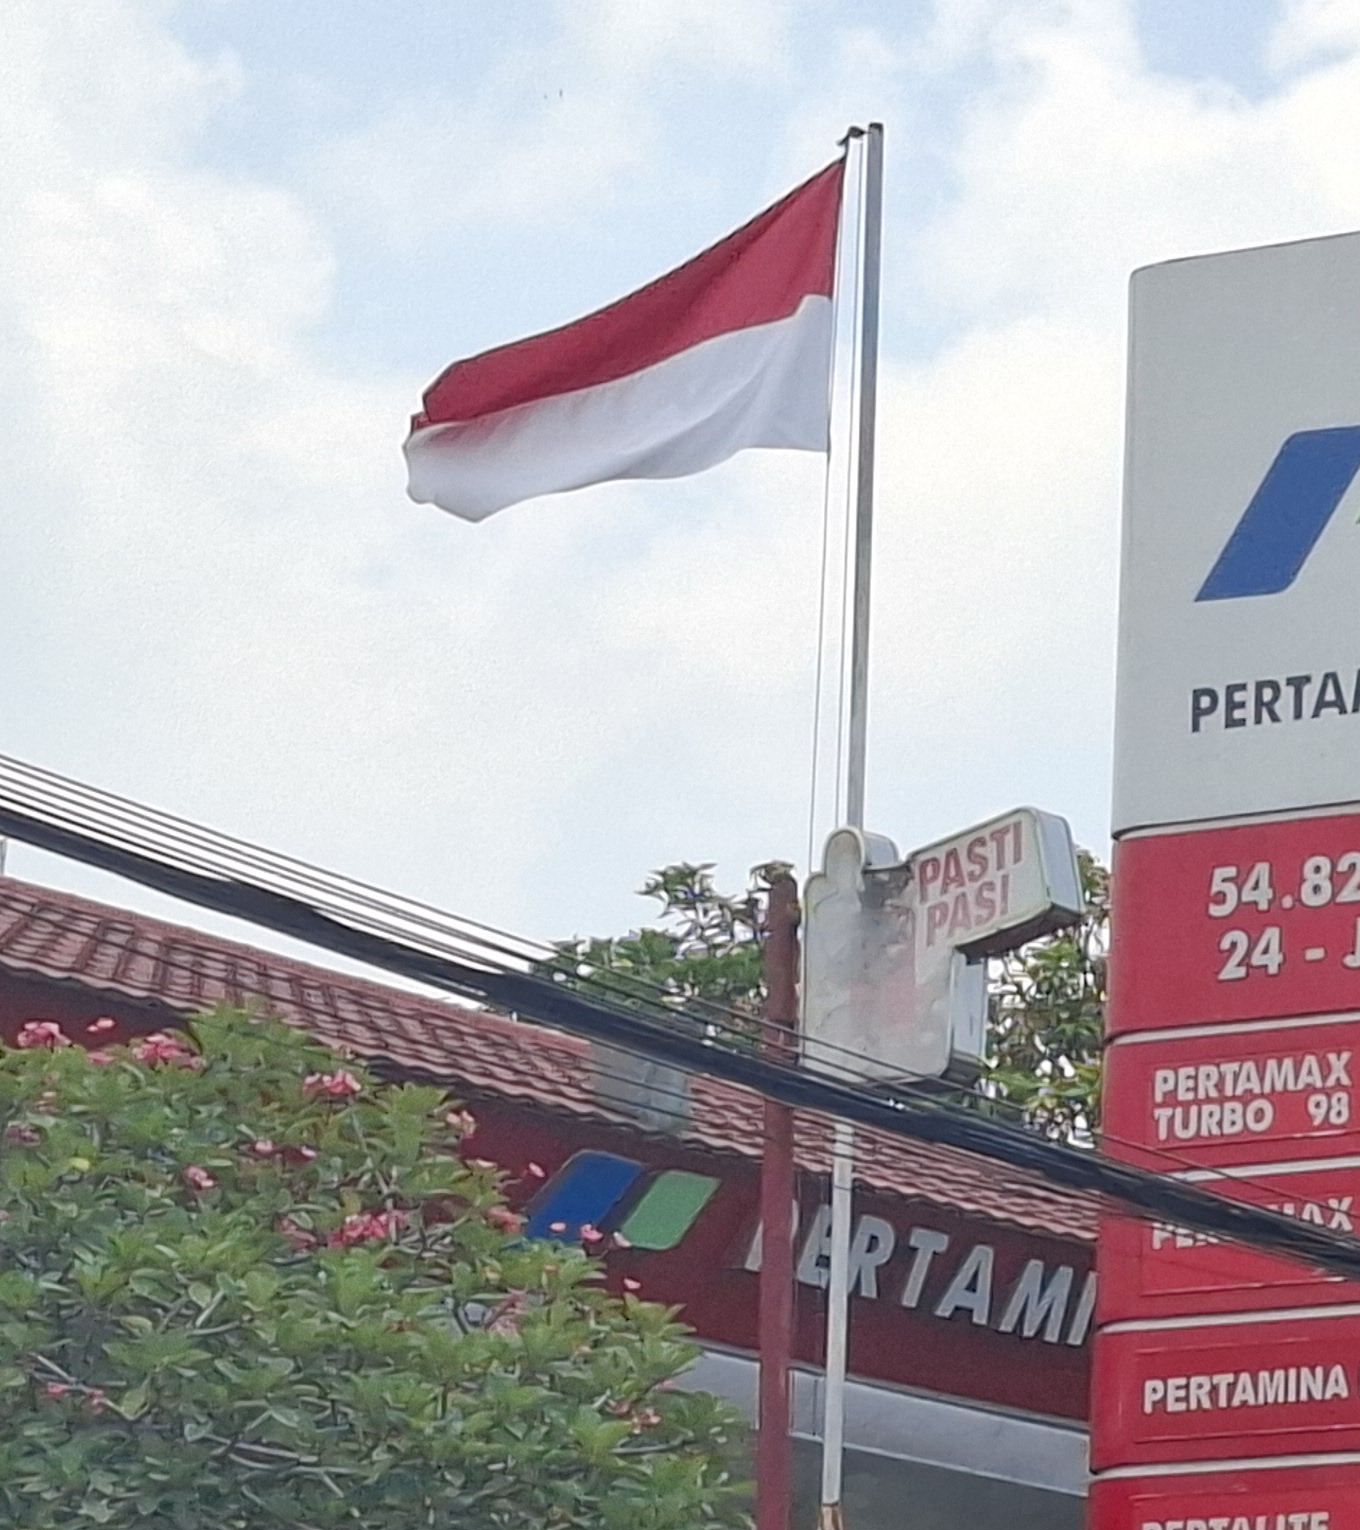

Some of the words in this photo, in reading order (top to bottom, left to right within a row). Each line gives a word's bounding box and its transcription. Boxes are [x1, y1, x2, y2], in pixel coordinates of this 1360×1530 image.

[918, 820, 1022, 904] PASTI
[1216, 926, 1284, 981] 24
[1153, 1051, 1353, 1103] PERTAMAX
[1153, 1099, 1275, 1141] TURBO
[1306, 1091, 1351, 1127] 98
[1143, 1364, 1348, 1414] PERTAMINA
